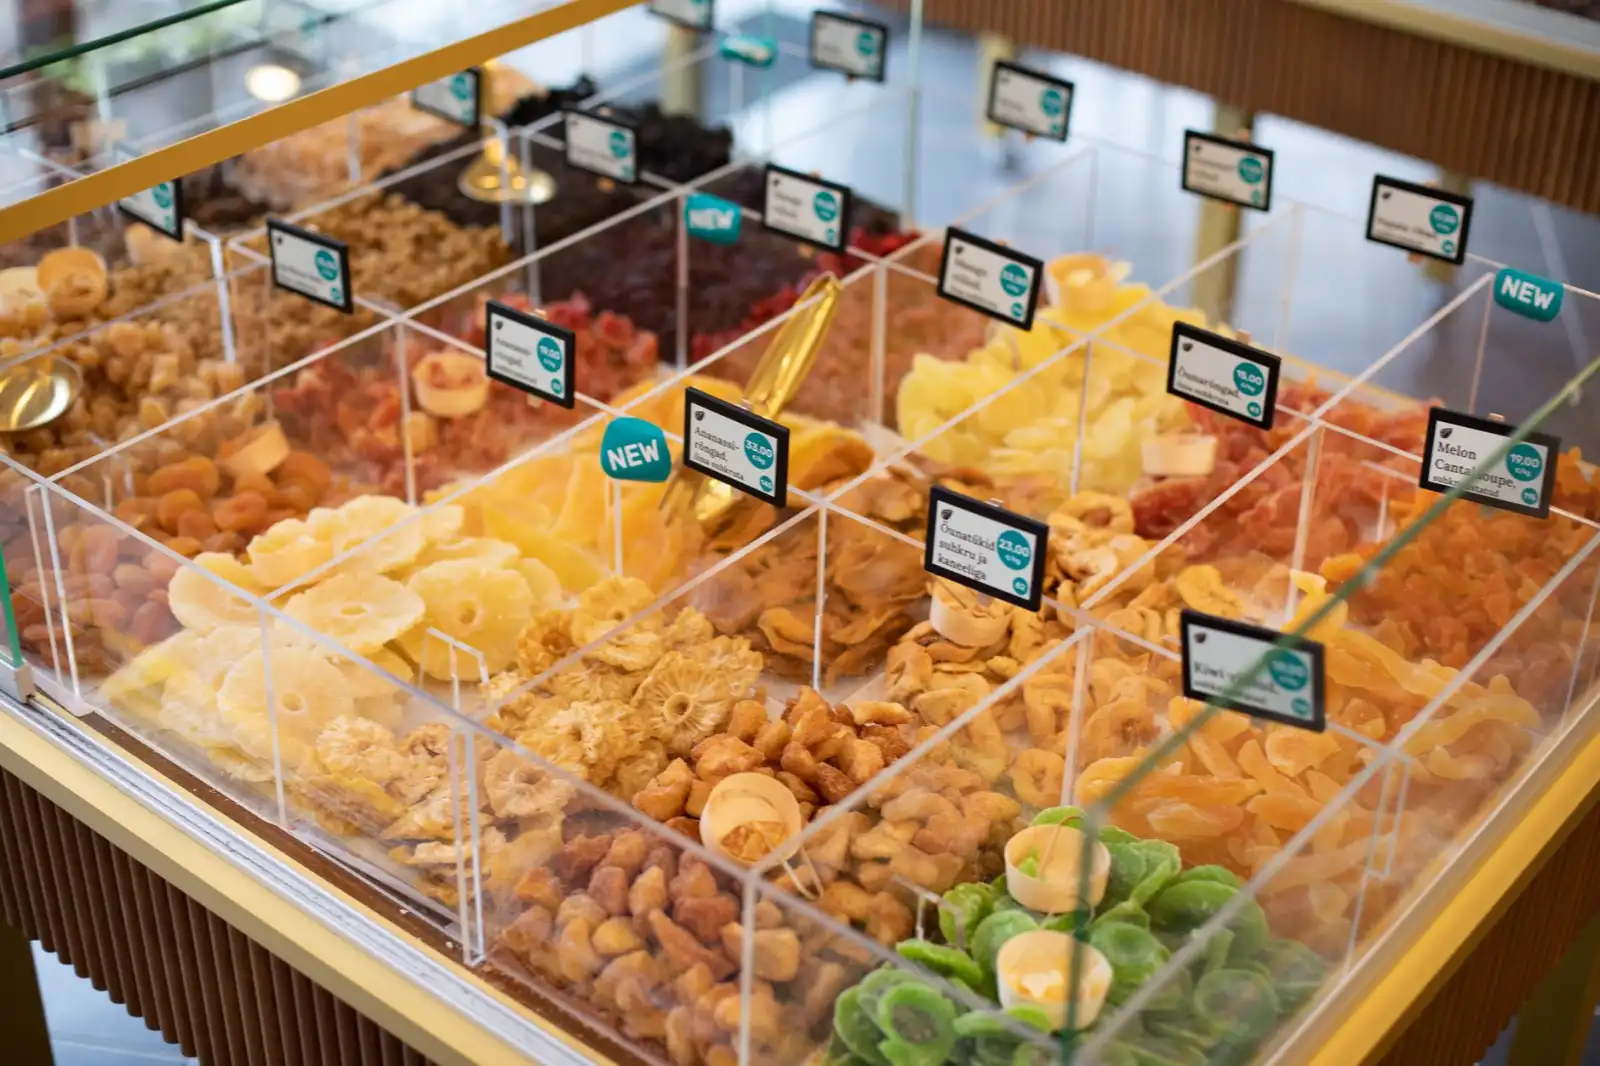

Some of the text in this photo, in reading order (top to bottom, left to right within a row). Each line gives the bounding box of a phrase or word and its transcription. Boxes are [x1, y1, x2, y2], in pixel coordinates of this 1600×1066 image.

[1501, 274, 1556, 310] NEW
[607, 438, 660, 471] NEW
[1437, 440, 1477, 461] Melon
[938, 540, 988, 566] suhkru ja
[938, 552, 987, 581] kaneeliga
